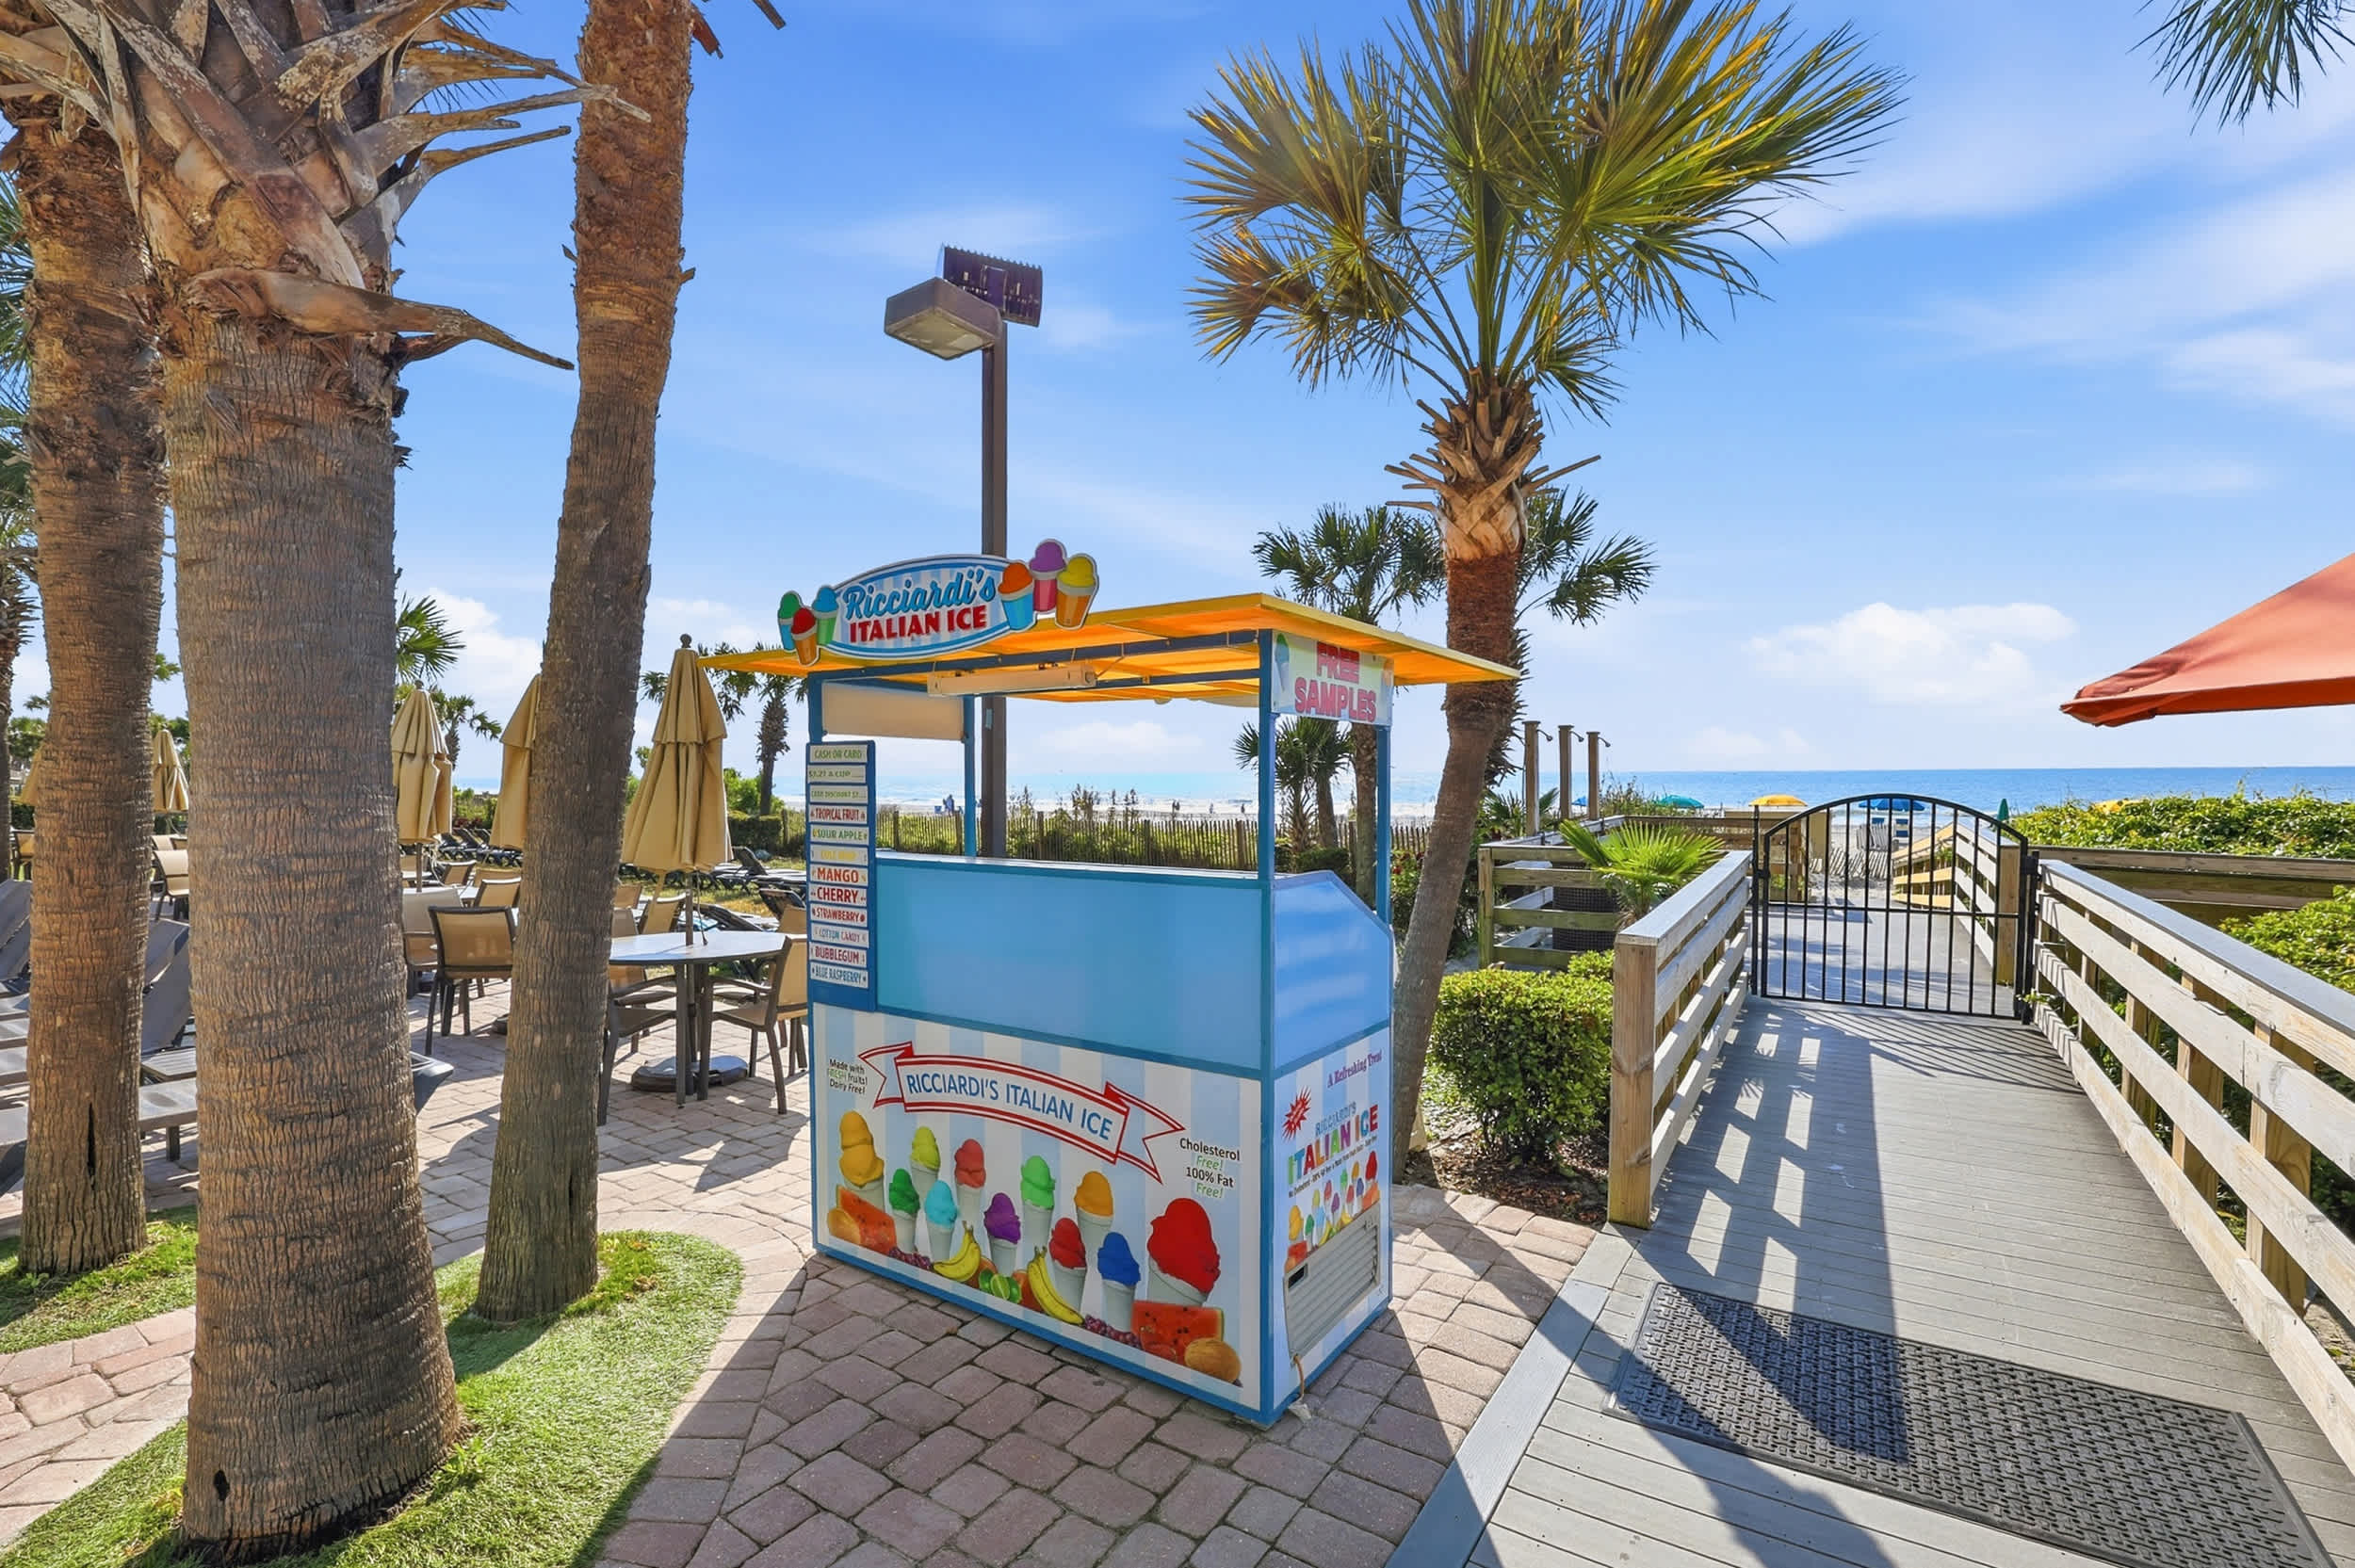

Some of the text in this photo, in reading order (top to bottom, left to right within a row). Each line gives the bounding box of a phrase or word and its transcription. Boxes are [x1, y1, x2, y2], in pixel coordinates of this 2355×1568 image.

[843, 566, 997, 621] Ricciardi's
[849, 604, 987, 643] ITALIAN ICE
[1316, 641, 1360, 685] FREE
[1294, 676, 1376, 723] SAMPLES
[814, 750, 862, 759] CASH OR CARD
[815, 808, 859, 821] TROPICAL FRUIT
[818, 829, 863, 841] SOUR APPLE
[817, 867, 860, 883] MANGO
[817, 887, 859, 903] CHERRY
[816, 908, 859, 924] STRAWBERRY
[820, 928, 860, 940] COTTON CANDY
[815, 946, 860, 962] BUBBLEGUM
[815, 965, 862, 984] BLUE RASPBERRY
[829, 1059, 865, 1075] Made with
[829, 1078, 847, 1092] Dairy
[906, 1072, 1113, 1140] RICCIARDI'S ITALIAN ICE
[1179, 1137, 1241, 1161] Cholesterol
[1288, 1120, 1351, 1186] ITALIAN
[1355, 1104, 1379, 1141] ICE
[1195, 1155, 1224, 1171] Free!
[1186, 1167, 1235, 1188] 100% Fat
[1195, 1182, 1225, 1199] Free!
